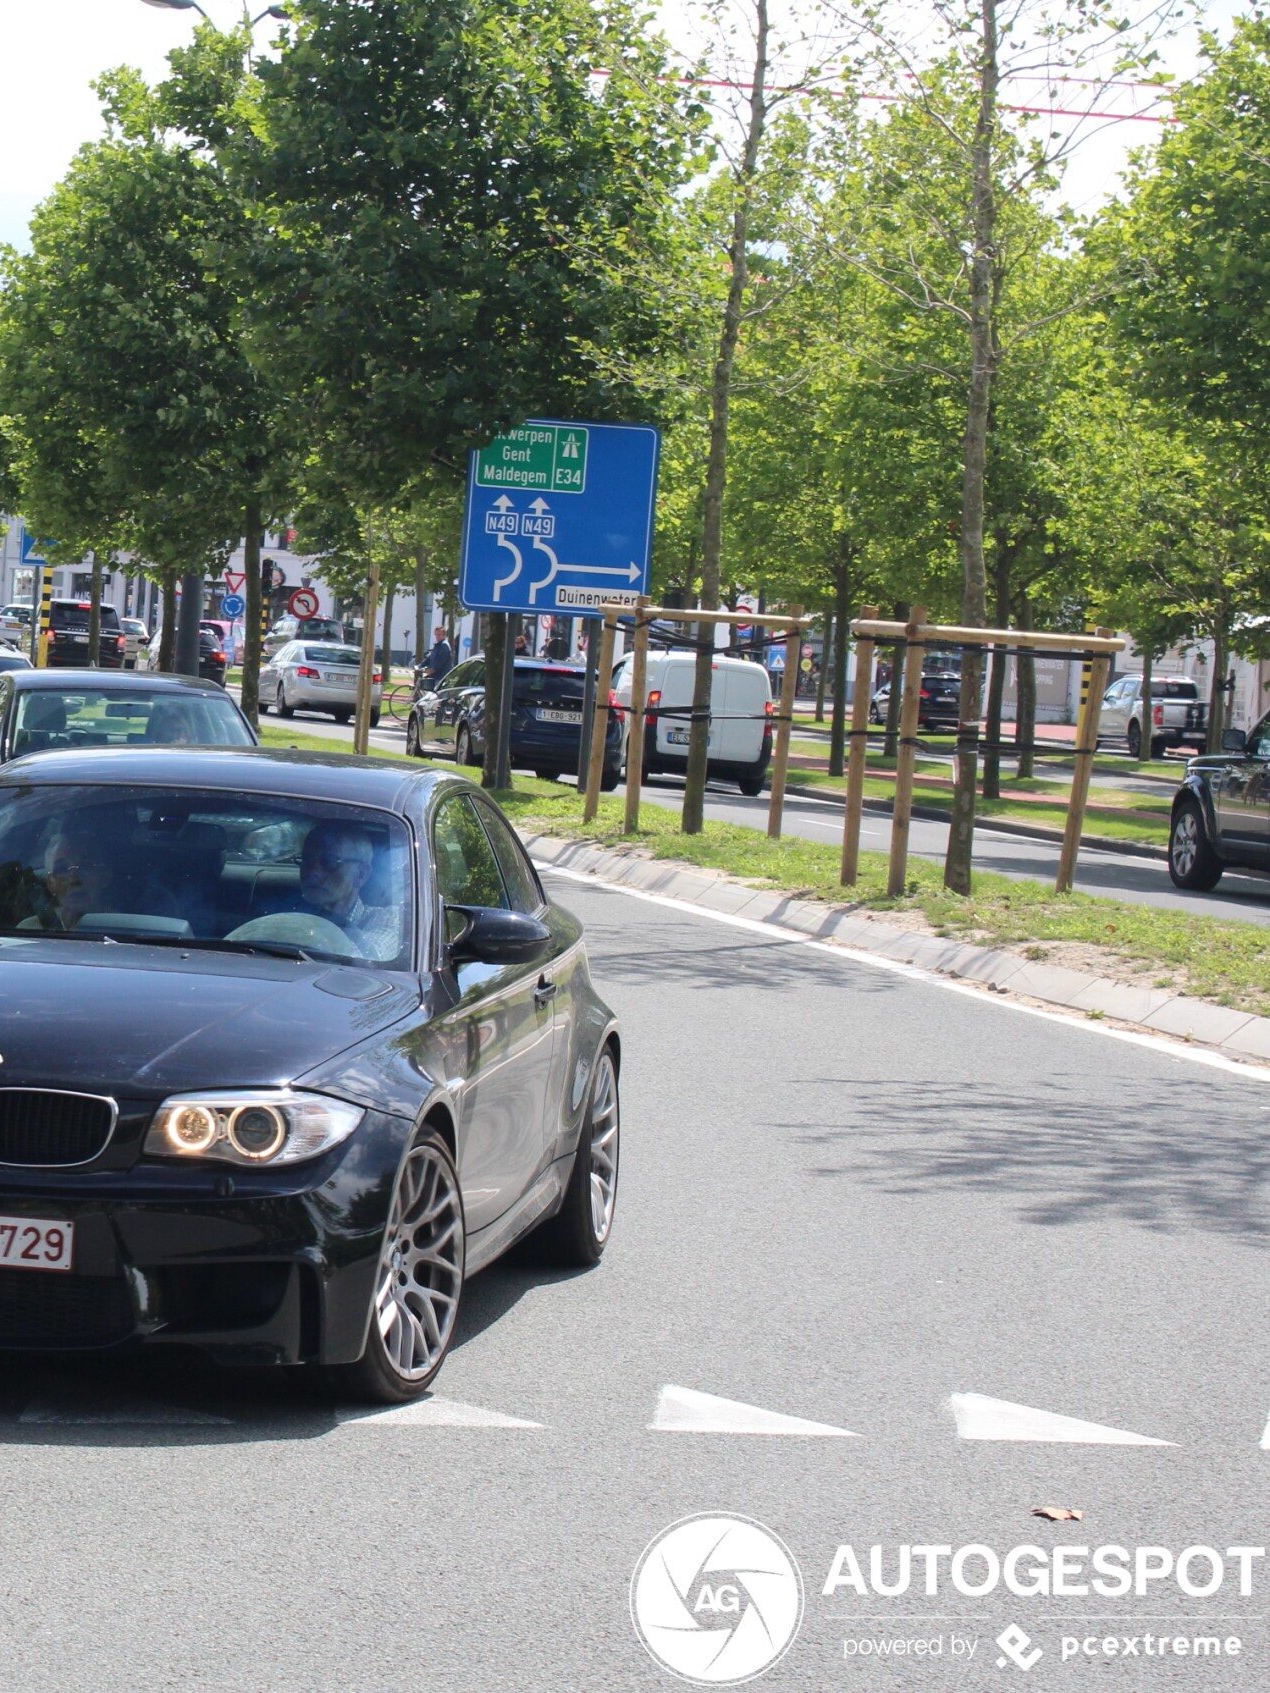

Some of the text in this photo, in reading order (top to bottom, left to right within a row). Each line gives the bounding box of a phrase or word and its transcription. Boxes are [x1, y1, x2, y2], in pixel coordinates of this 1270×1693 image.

[502, 446, 531, 462] Gent
[483, 465, 546, 486] Maldegem
[555, 468, 581, 485] E34
[489, 516, 515, 531] N49
[525, 519, 551, 534] N49
